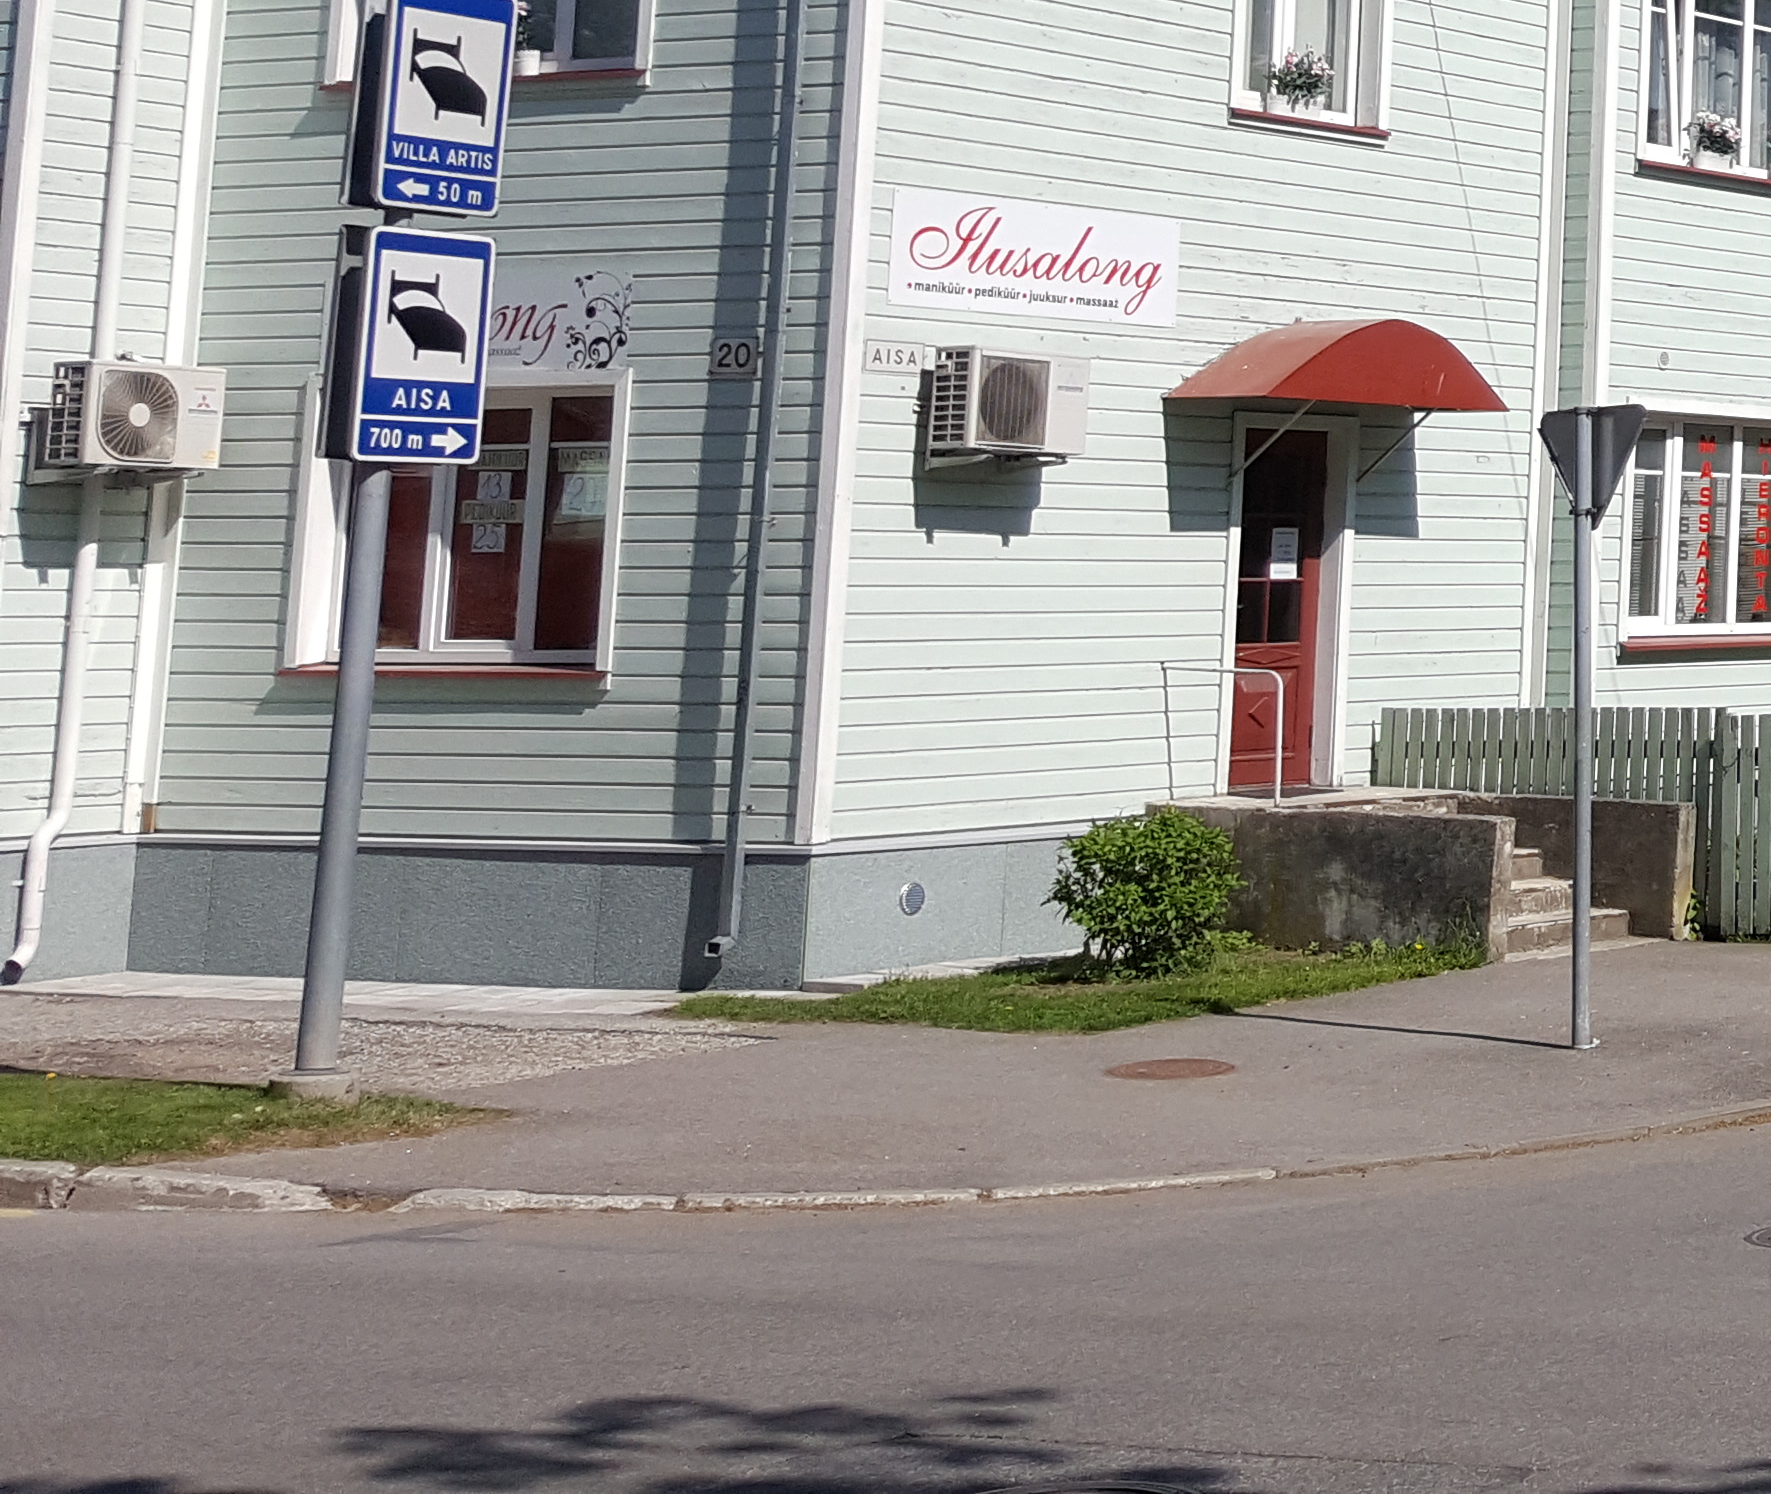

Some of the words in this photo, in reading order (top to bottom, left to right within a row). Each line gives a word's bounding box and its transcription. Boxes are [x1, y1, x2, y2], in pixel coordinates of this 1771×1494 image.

[392, 140, 440, 164] VILLA
[446, 148, 494, 170] ARTIS
[437, 181, 461, 203] 50
[467, 190, 482, 205] m
[909, 206, 1163, 316] Ilusalong
[1028, 291, 1068, 305] juuksur
[717, 342, 751, 368] 20
[871, 347, 918, 367] AISA
[391, 387, 452, 410] AISA
[370, 427, 402, 449] 700
[407, 434, 423, 450] m
[482, 473, 503, 500] 13
[1695, 434, 1717, 614] MASSAAŽ
[473, 525, 503, 549] 25
